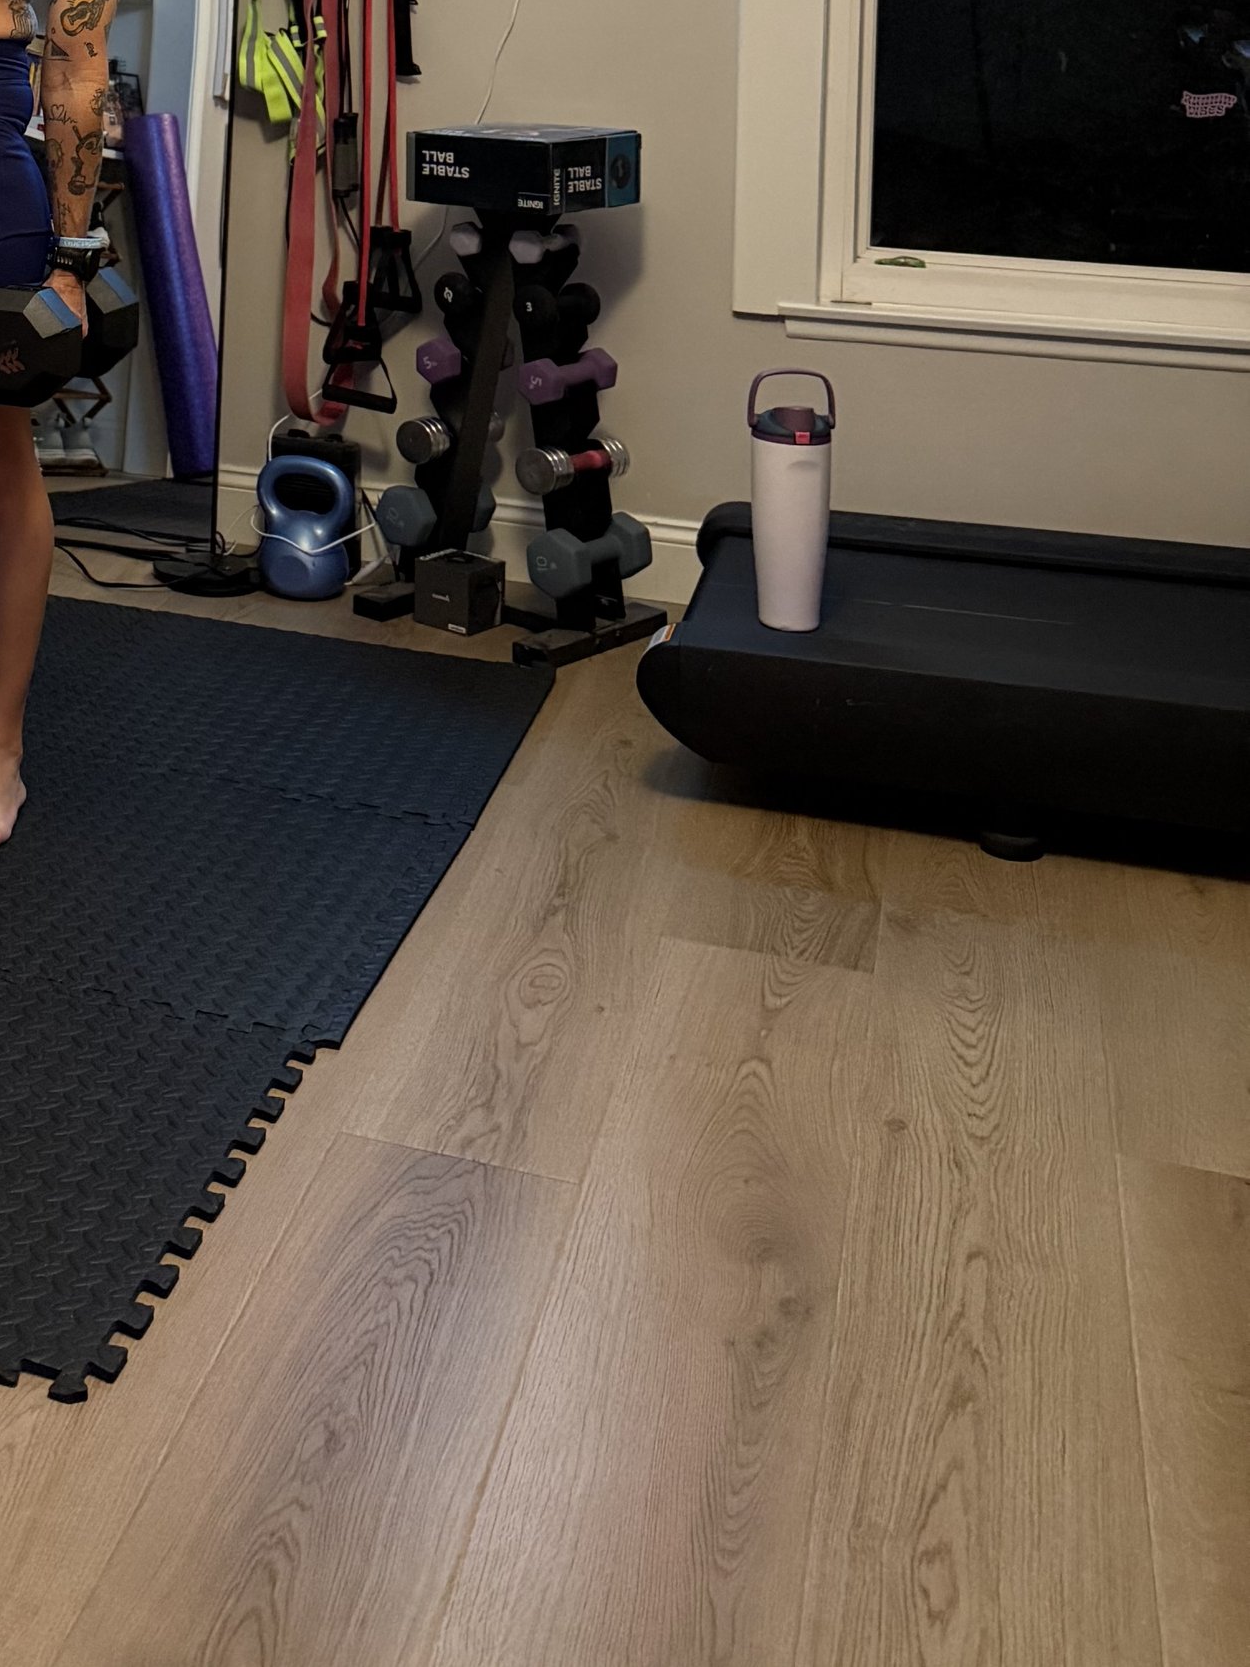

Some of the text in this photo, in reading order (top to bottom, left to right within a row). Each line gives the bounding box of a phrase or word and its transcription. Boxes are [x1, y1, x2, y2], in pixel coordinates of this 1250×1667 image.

[422, 150, 454, 163] BALL
[422, 163, 470, 179] STABLE
[568, 165, 592, 177] BALL
[553, 168, 561, 206] IGNITE
[568, 177, 602, 193] STABLE
[517, 198, 544, 209] IGNITE
[423, 356, 433, 370] 5
[530, 375, 543, 387] 5
[536, 555, 549, 571] 10
